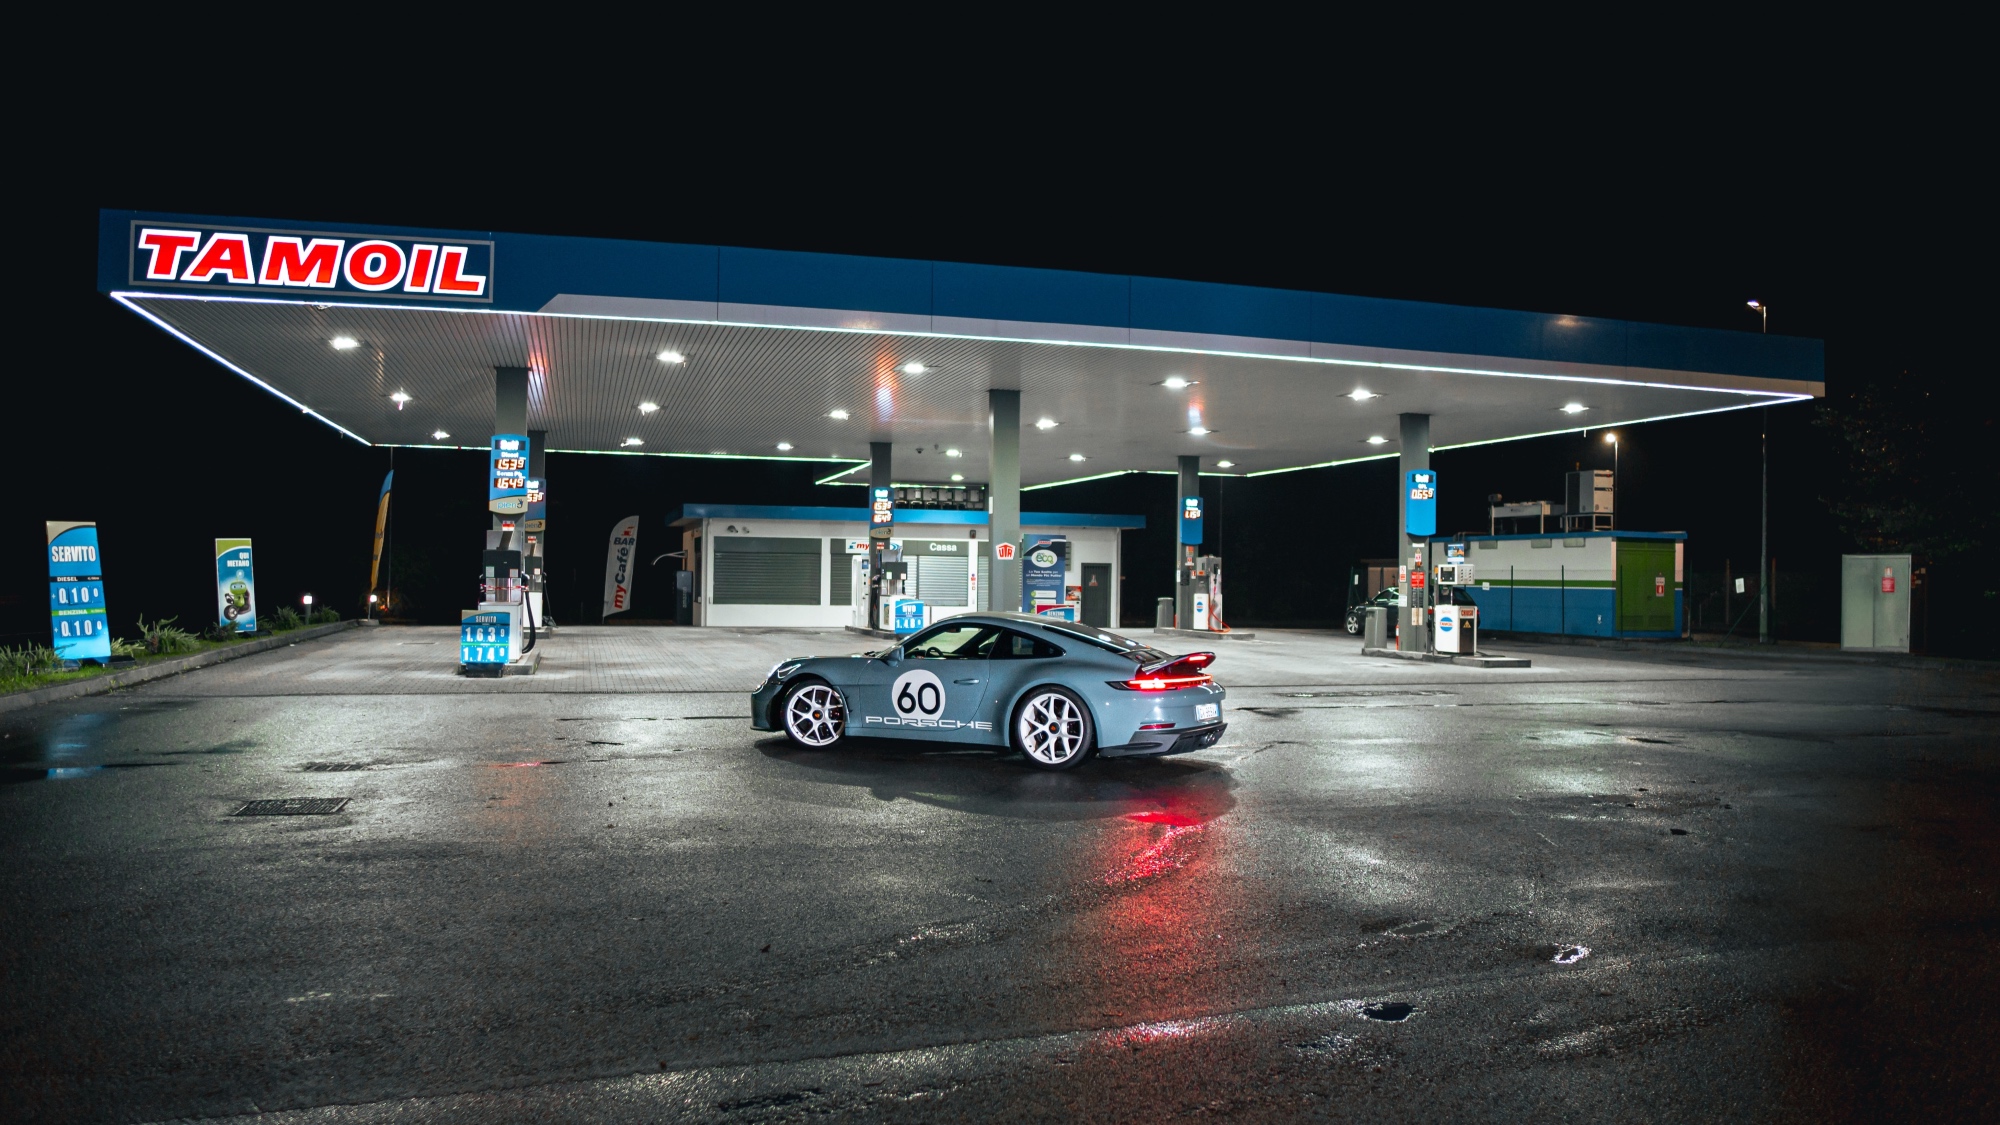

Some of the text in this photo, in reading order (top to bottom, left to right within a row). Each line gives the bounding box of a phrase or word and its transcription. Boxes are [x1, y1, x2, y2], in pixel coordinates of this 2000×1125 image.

[138, 228, 486, 295] TAMOIL
[613, 537, 635, 546] BAR
[929, 542, 957, 552] Cassa
[51, 545, 97, 563] SERVITO
[475, 615, 497, 623] SERVITO
[897, 682, 941, 715] 60
[865, 715, 993, 730] PORSCHE
